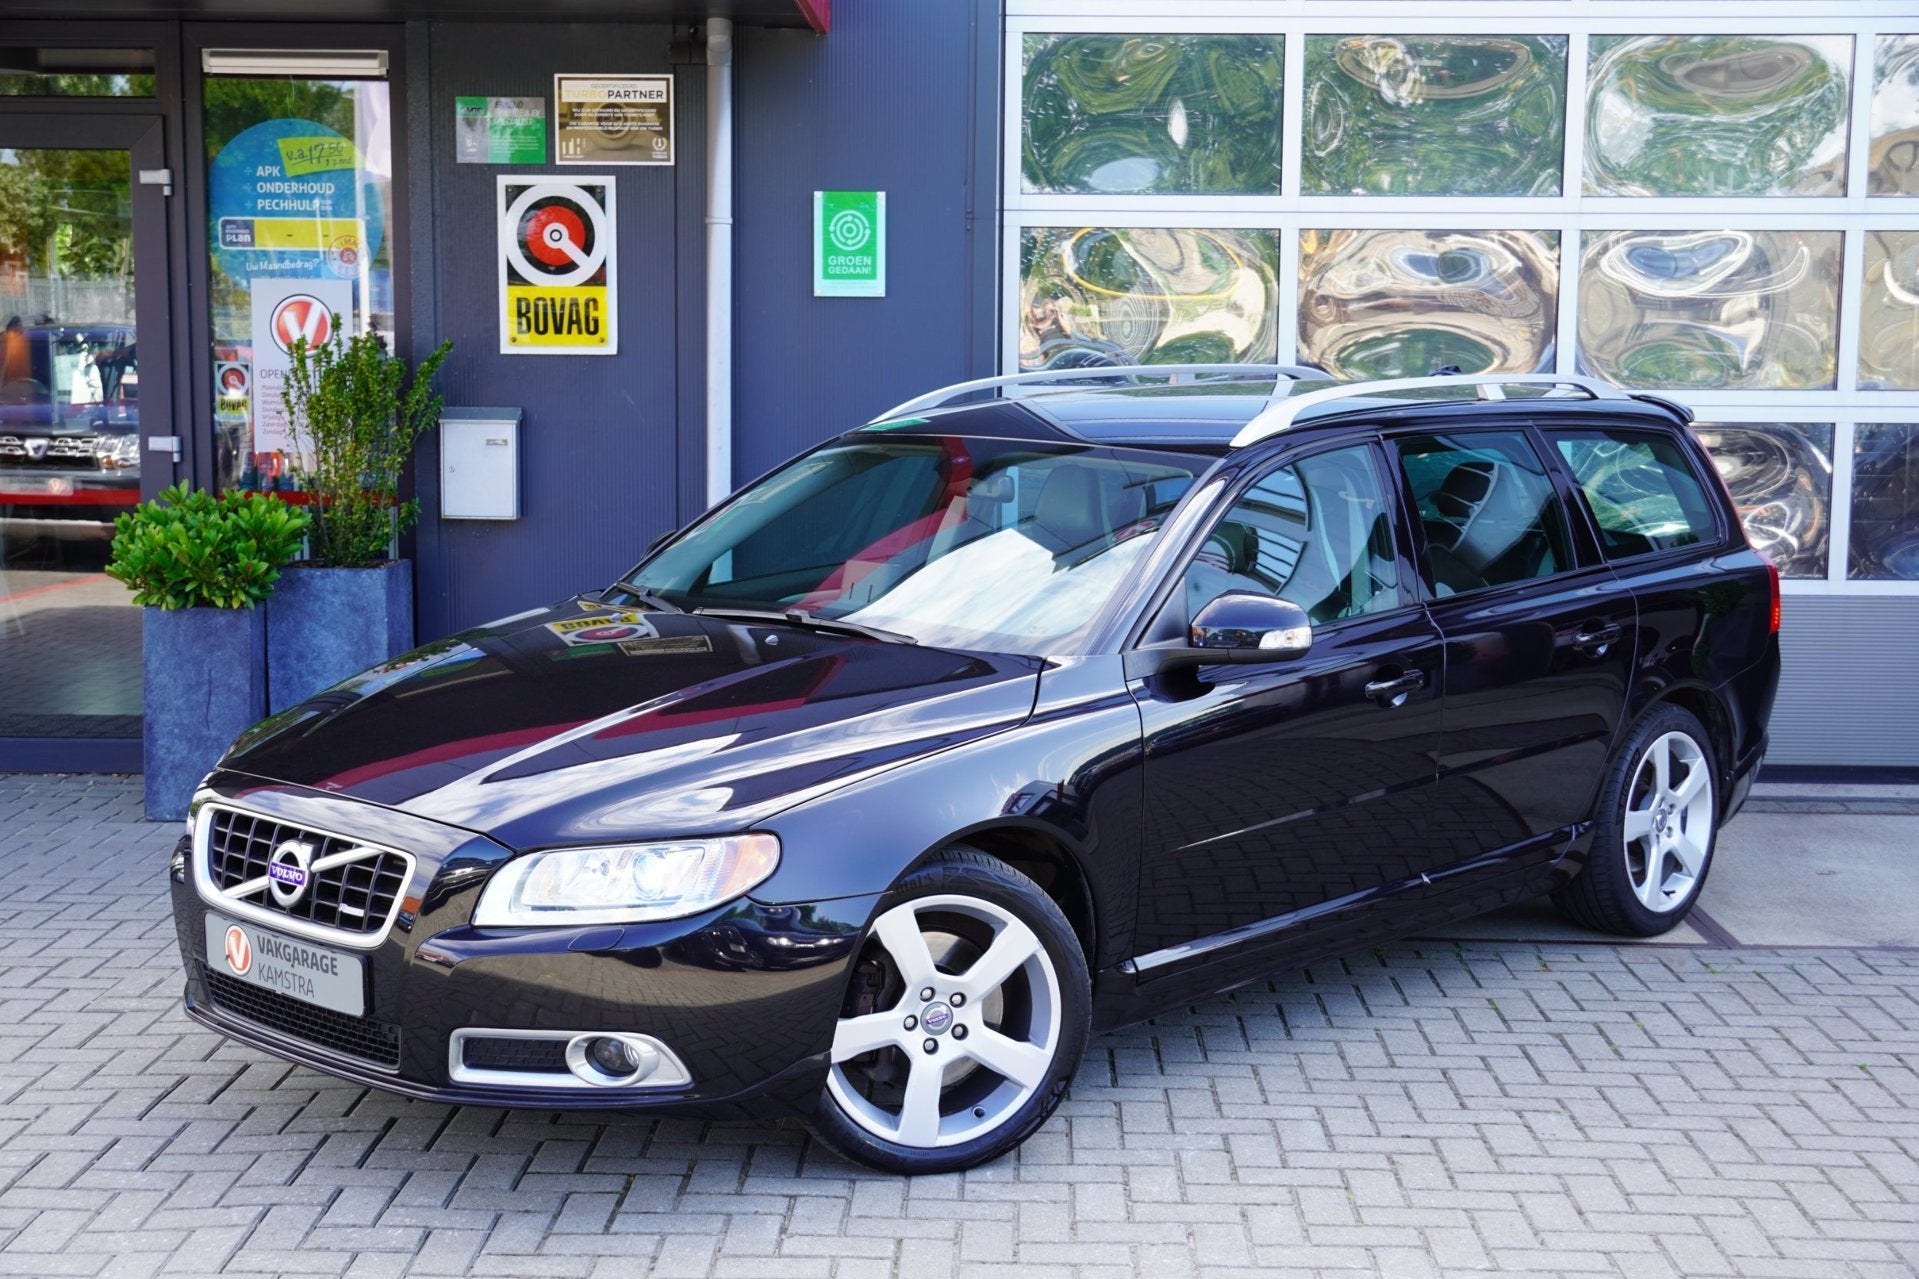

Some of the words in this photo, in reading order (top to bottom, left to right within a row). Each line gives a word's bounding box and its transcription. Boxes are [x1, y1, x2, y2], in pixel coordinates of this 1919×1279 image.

[256, 165, 281, 177] APK
[256, 182, 335, 194] ONDERHOUD
[246, 262, 259, 271] Uw
[828, 255, 872, 266] GROEN
[828, 266, 872, 274] GEDAAN!
[516, 296, 599, 336] BOVAG
[271, 865, 303, 882] VOLVO
[256, 934, 339, 976] VAKGARAGE
[258, 962, 315, 998] KAMSTRA
